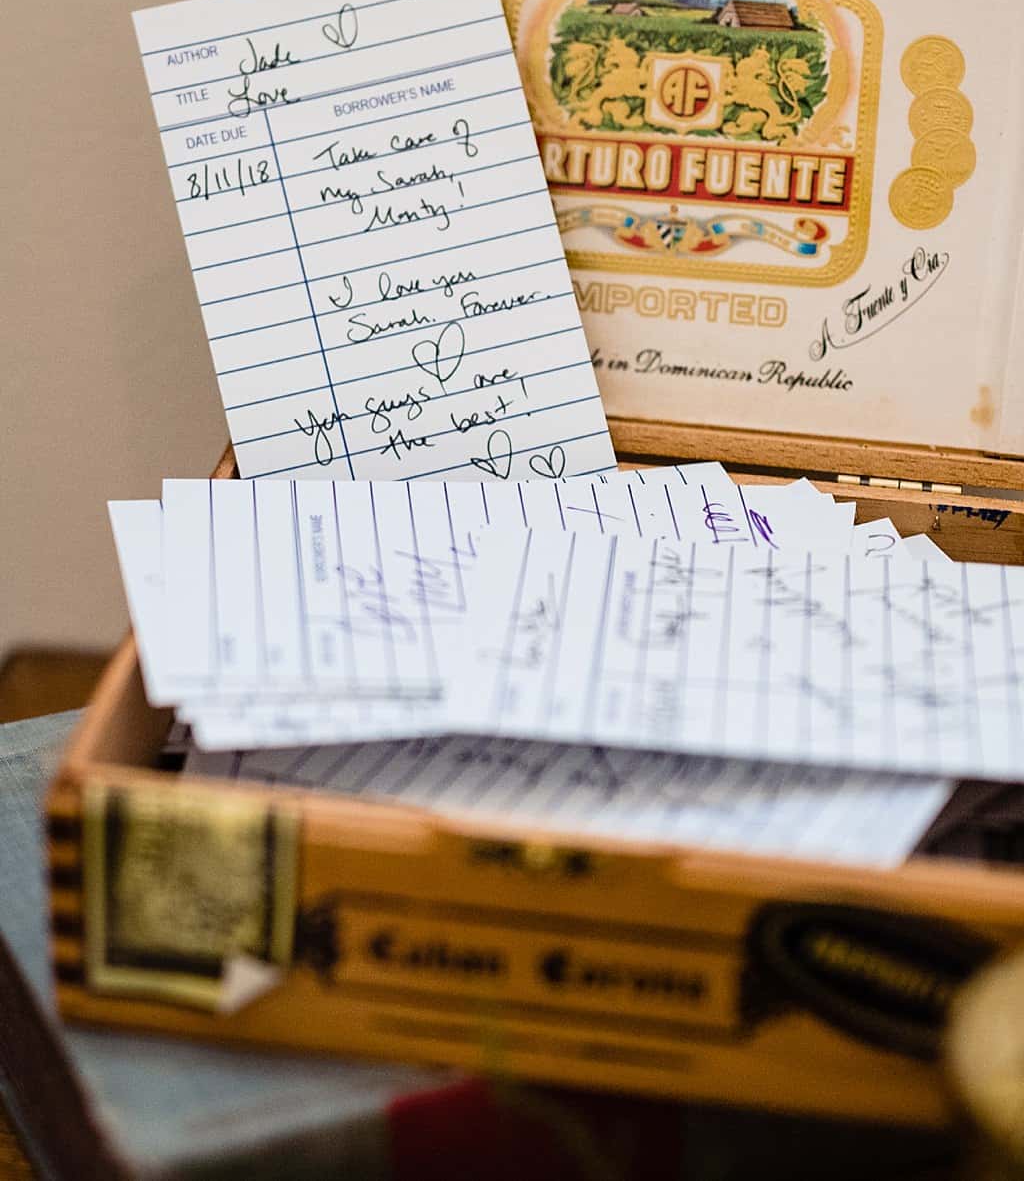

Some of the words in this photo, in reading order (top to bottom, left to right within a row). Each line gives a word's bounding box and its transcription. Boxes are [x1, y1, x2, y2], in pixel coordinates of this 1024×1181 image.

[167, 45, 218, 67] AUTHOR
[176, 87, 210, 106] TITLE
[333, 88, 420, 117] BORROWER'S
[420, 77, 457, 99] NAME
[186, 133, 218, 150] DATE
[220, 125, 248, 146] DUE
[312, 140, 377, 171] Take
[187, 158, 271, 200] 8/11/18
[544, 138, 672, 192] RTURO
[678, 147, 846, 205] FUENTE
[380, 272, 425, 303] love
[432, 270, 477, 295] you
[573, 280, 788, 328] MPORTED
[634, 349, 753, 381] Dominican
[757, 360, 853, 392] Republic
[364, 386, 431, 434] guys
[379, 430, 437, 461] the
